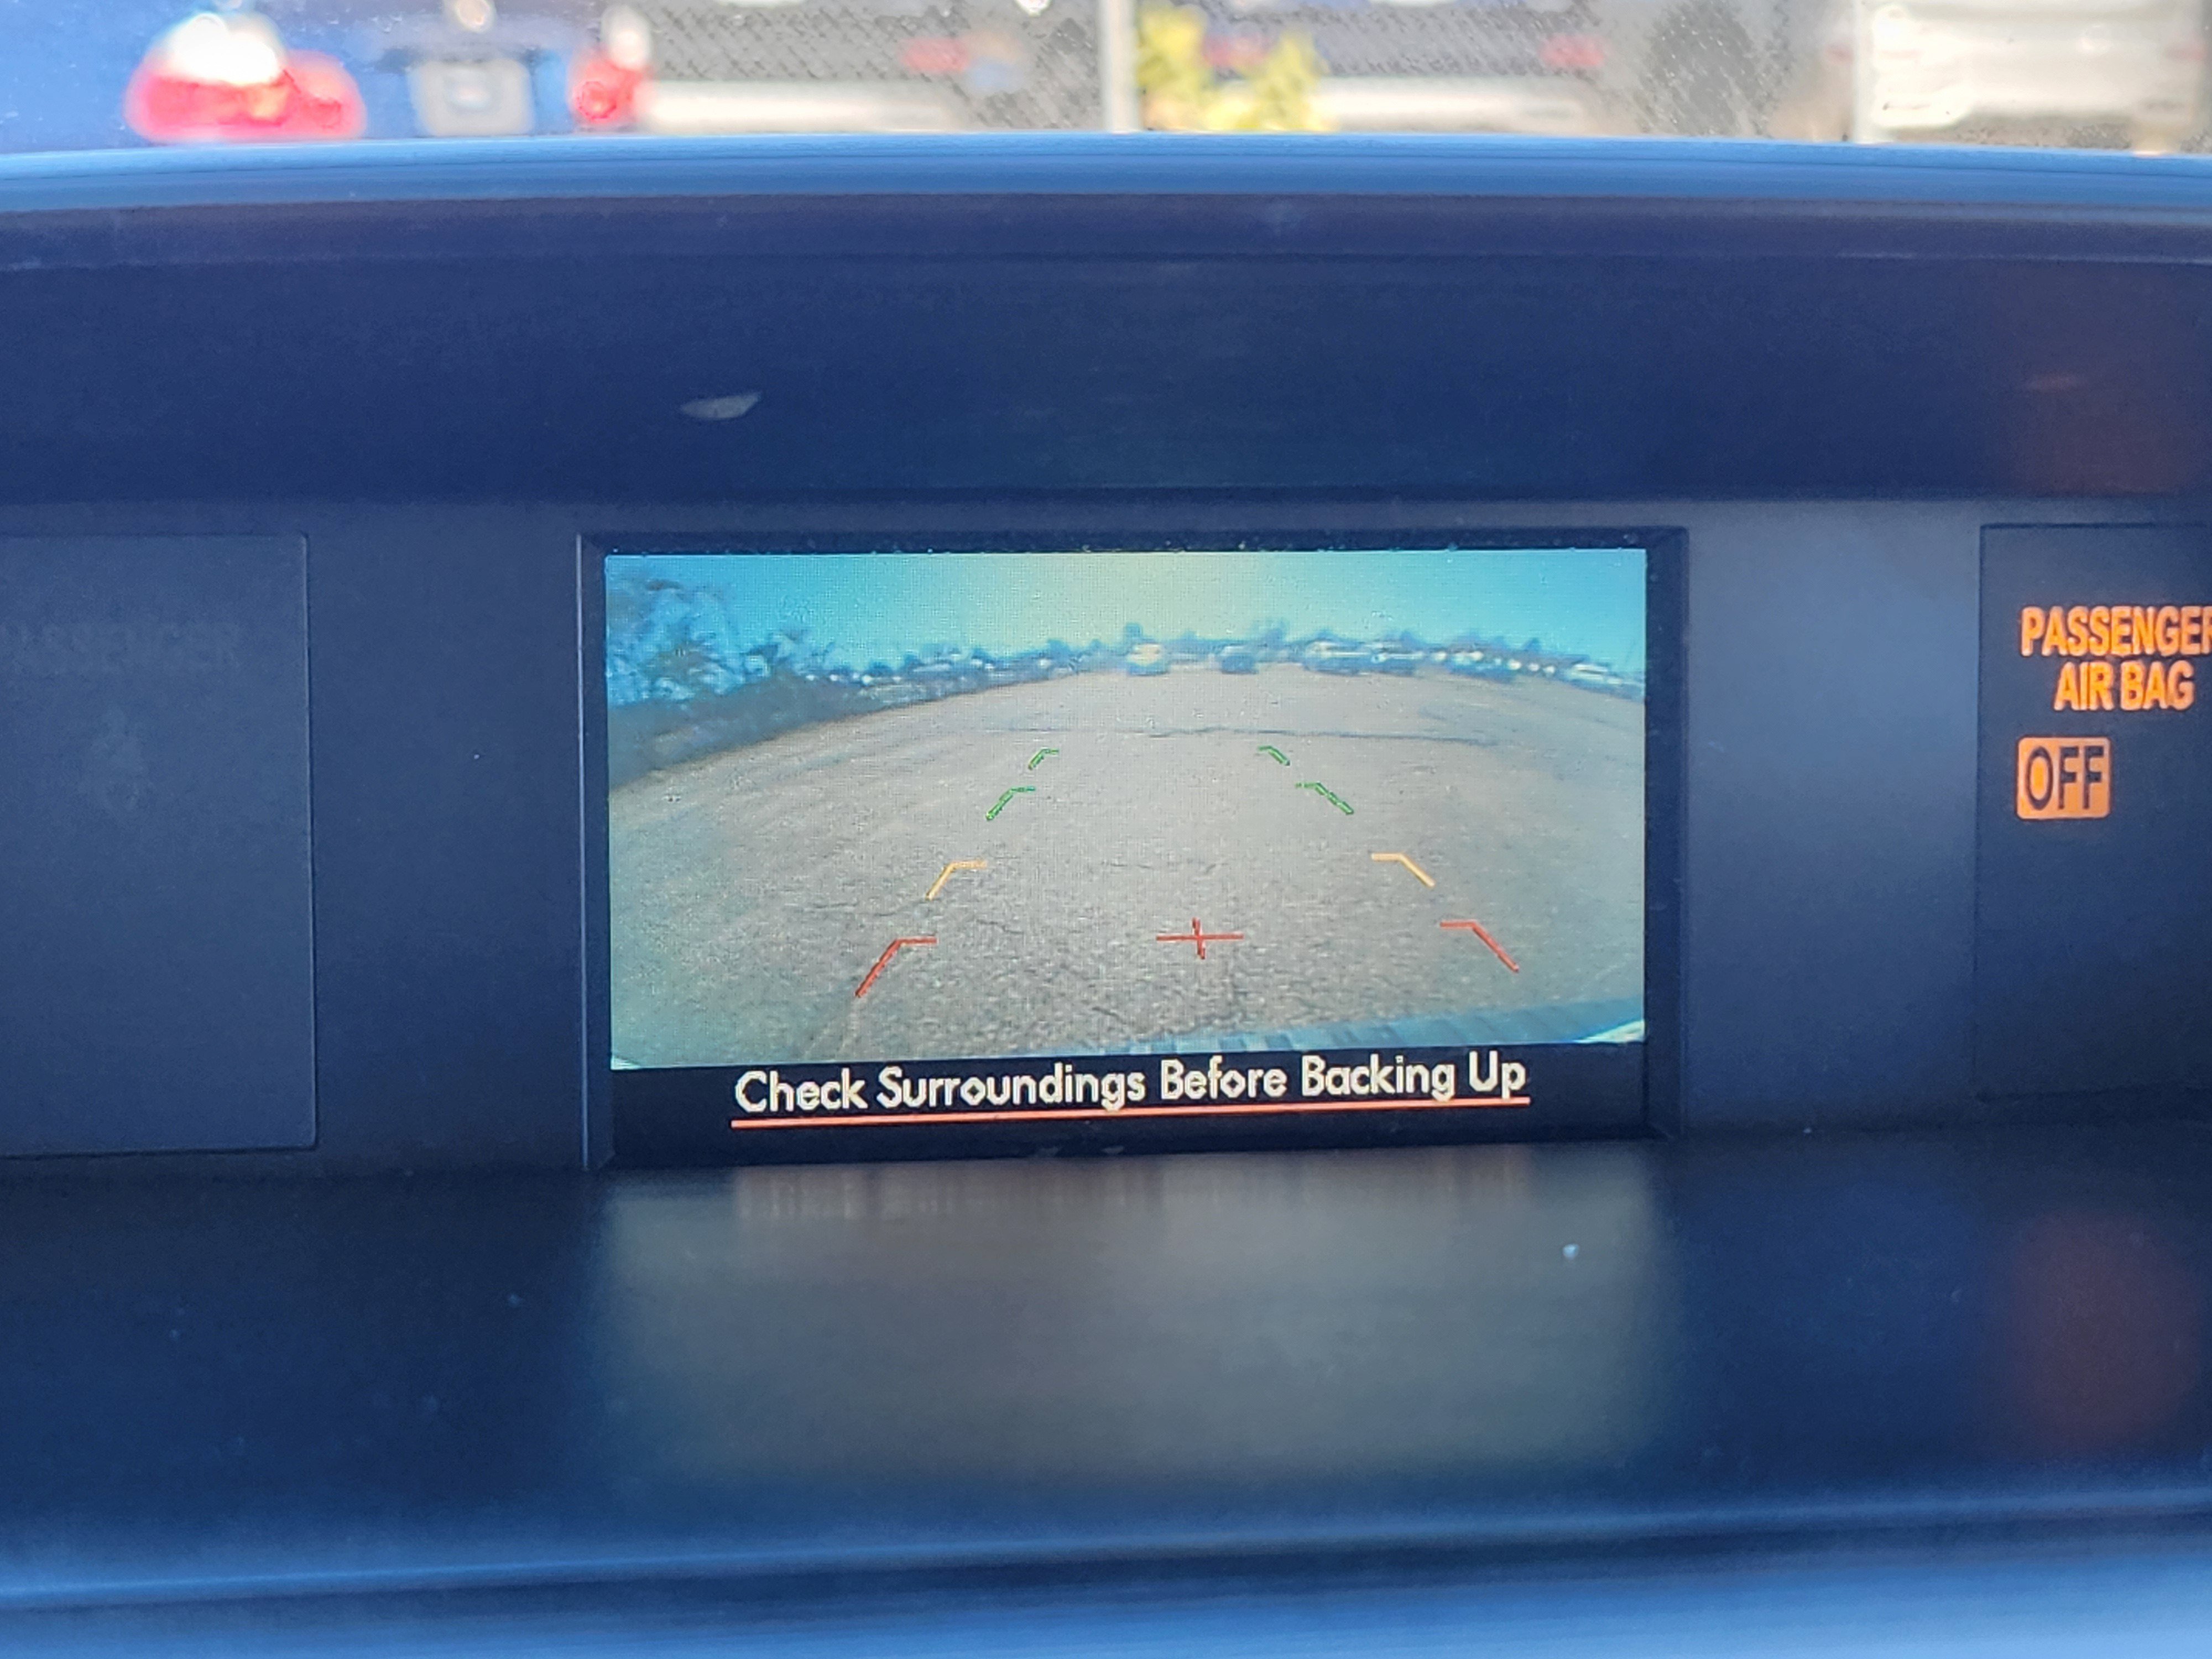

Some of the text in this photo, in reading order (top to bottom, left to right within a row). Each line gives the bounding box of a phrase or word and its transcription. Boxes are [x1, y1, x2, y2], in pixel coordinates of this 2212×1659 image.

[2053, 660, 2194, 711] AIR BAG
[2025, 746, 2105, 810] OFF
[734, 1050, 1527, 1113] Check Surroundings Before Backing Up
